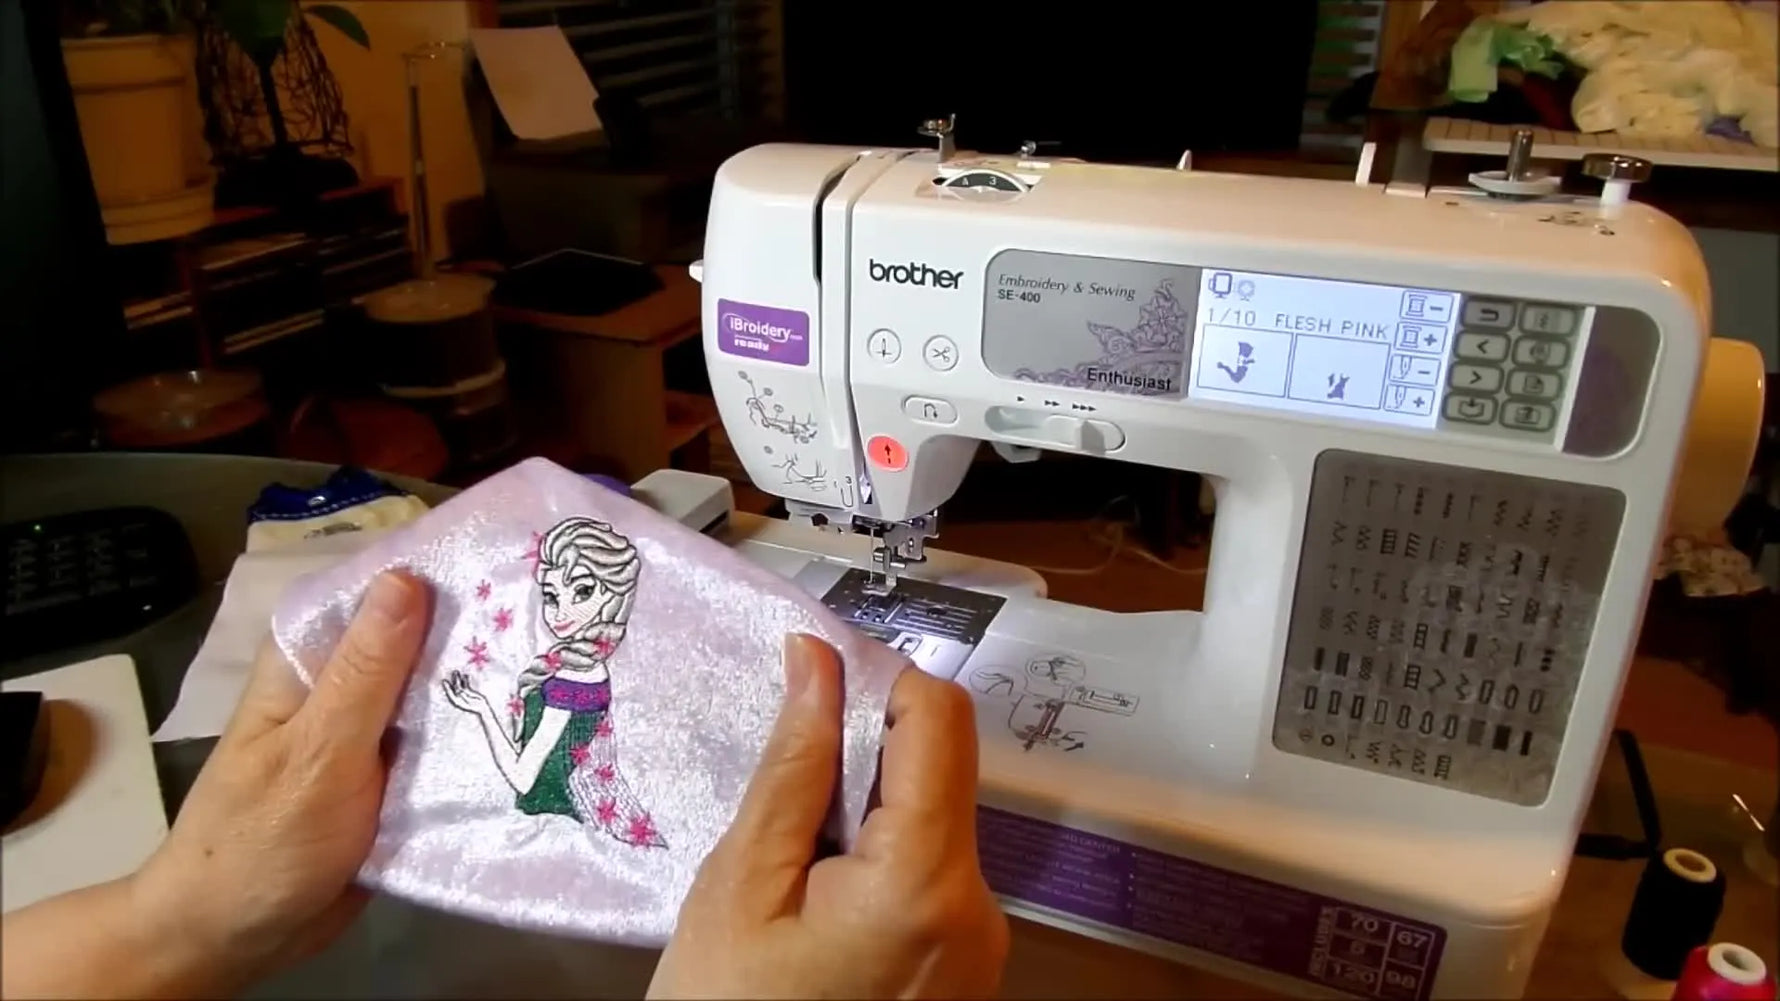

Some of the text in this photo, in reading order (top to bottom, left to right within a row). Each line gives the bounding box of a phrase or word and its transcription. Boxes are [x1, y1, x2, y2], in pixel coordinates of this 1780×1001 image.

[989, 176, 997, 185] 3
[869, 258, 965, 289] brother
[997, 288, 1042, 303] SE-400
[998, 272, 1137, 302] Embroidery & Sewing
[1208, 307, 1389, 340] 1/10 FLESH PINK
[733, 339, 771, 353] ready
[1086, 367, 1173, 391] Enthusiast
[1351, 914, 1379, 932] 70
[1396, 930, 1428, 949] 67
